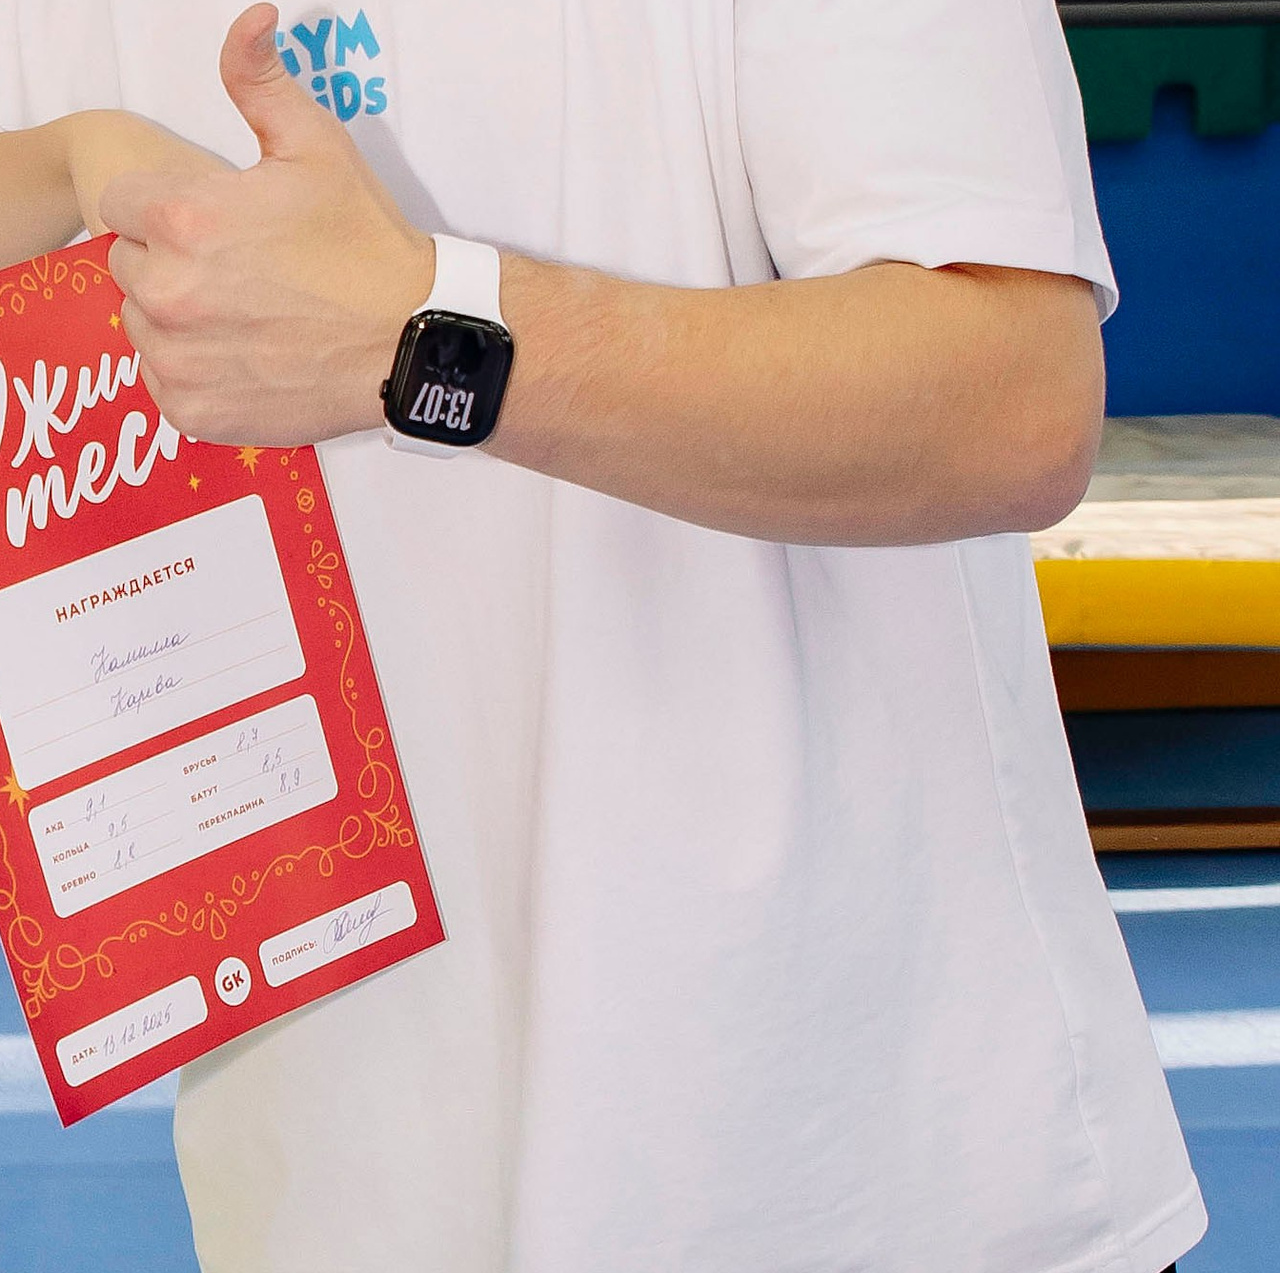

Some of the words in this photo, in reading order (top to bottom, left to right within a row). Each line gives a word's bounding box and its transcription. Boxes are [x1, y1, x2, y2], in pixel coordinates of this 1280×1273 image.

[311, 71, 387, 122] iDs
[409, 382, 474, 431] 13:07
[55, 557, 196, 623] НАГРАЖДАЕТСЯ
[182, 754, 218, 776] БРУСЬЯ
[190, 785, 218, 803] БАТУТ
[198, 797, 265, 832] ПЕРЕКЛАДИНА
[45, 820, 65, 836] АКД
[52, 841, 90, 865] КОЛЬЦА
[61, 870, 97, 893] БРЕВНО
[271, 939, 318, 966] ПОДПИСЬ:
[221, 970, 245, 993] GK
[71, 1046, 98, 1065] ДАТА:
